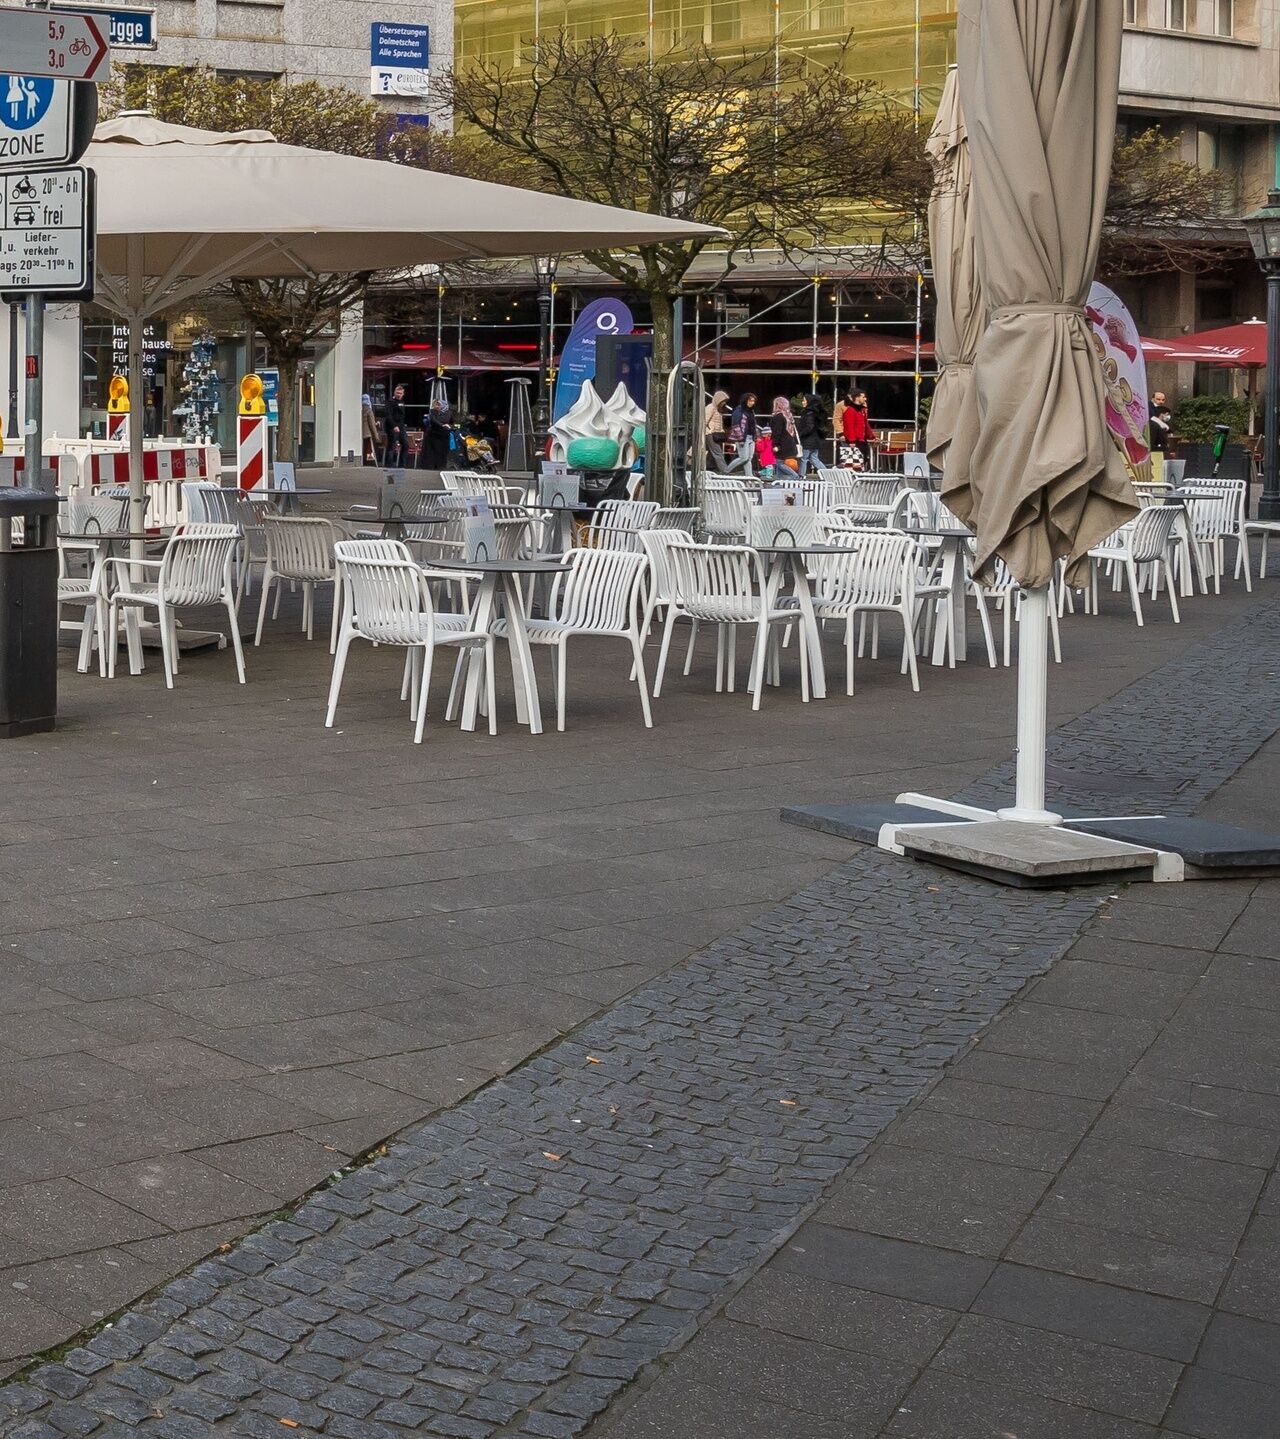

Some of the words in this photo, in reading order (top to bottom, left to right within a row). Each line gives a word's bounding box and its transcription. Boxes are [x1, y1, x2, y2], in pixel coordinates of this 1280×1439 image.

[48, 21, 65, 40] 5,9
[110, 17, 143, 41] ügge
[379, 24, 427, 38] Übersetzungen
[379, 37, 420, 47] Dolmetschen
[48, 49, 65, 68] 3,0
[379, 48, 391, 57] Alle
[393, 48, 422, 59] Sprachen
[0, 134, 45, 157] ZONE
[43, 205, 63, 225] frei
[25, 232, 57, 242] Liefer-
[24, 246, 59, 256] verkehr
[68, 260, 74, 270] h
[12, 274, 30, 285] frei
[113, 325, 154, 336] Intet
[112, 338, 128, 350] für
[142, 338, 174, 349] hause.
[582, 338, 596, 346] Mob
[113, 351, 128, 363] Für
[112, 365, 156, 377] Zuhse.
